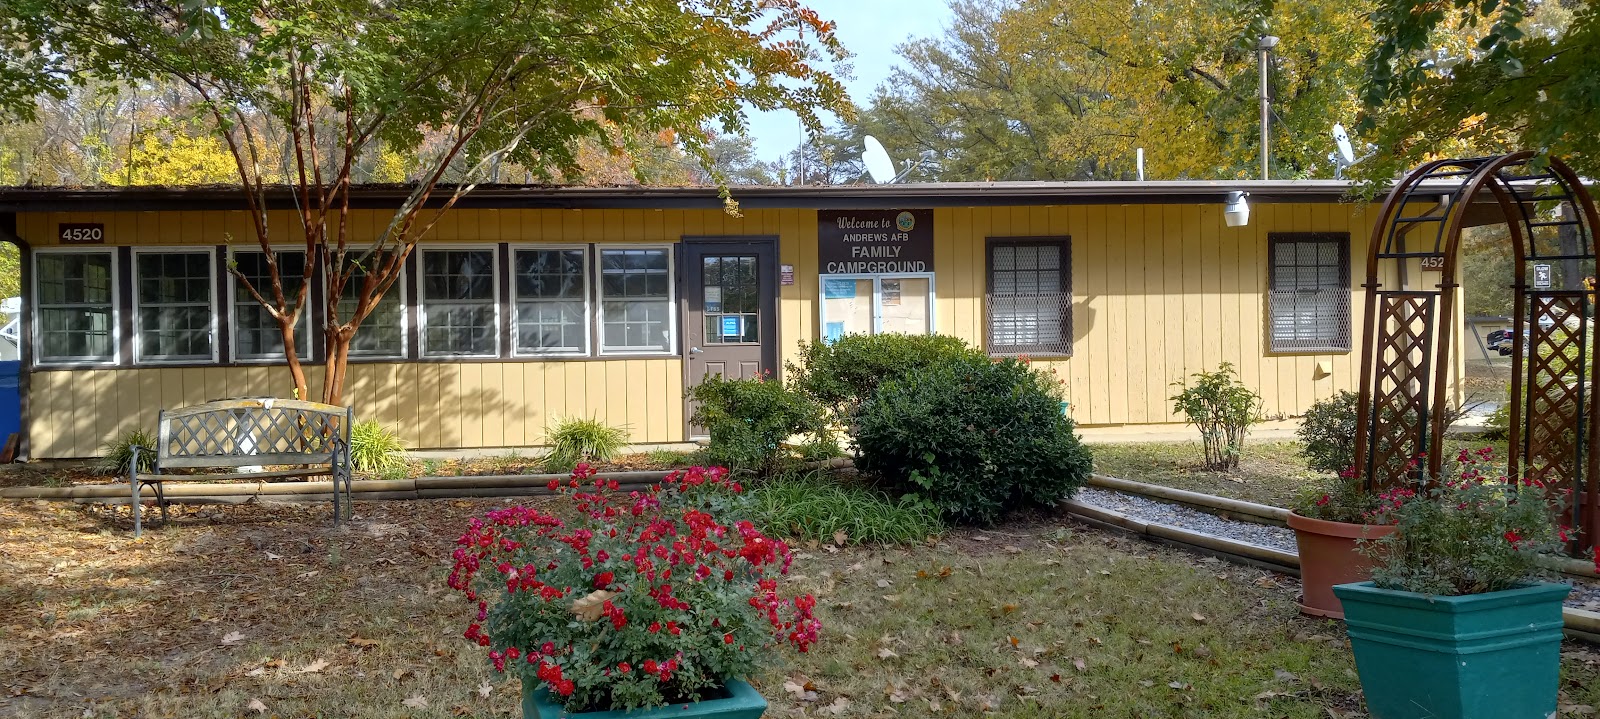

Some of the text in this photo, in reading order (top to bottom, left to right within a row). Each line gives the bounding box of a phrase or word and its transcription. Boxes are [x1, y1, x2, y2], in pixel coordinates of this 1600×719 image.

[837, 216, 891, 229] Welcome to
[62, 228, 102, 241] 4520
[843, 233, 909, 242] ANDREWS AFB
[851, 245, 902, 258] FAMILY
[827, 261, 926, 274] CAMPGROUND
[1421, 256, 1445, 268] 452
